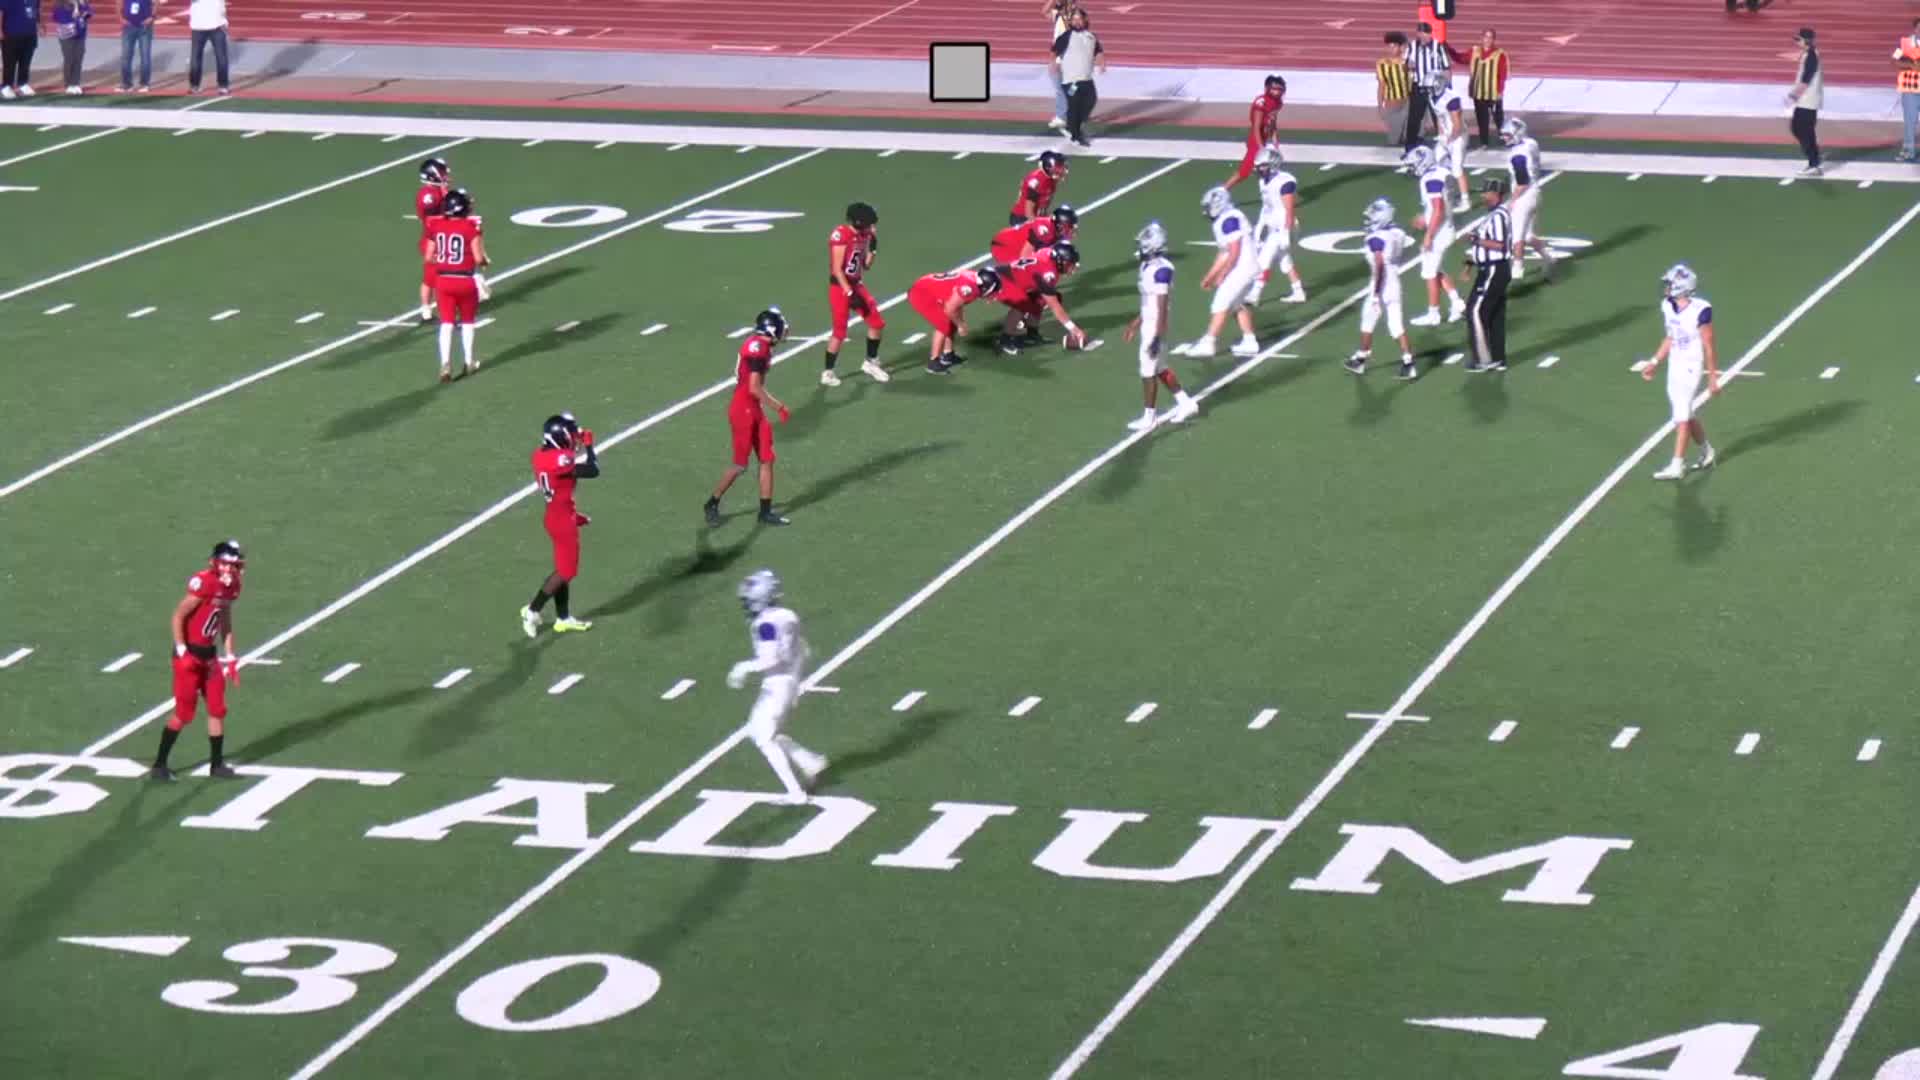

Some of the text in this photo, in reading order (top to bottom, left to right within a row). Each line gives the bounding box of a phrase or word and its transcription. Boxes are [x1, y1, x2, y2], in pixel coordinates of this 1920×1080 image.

[510, 204, 806, 233] 20
[436, 232, 464, 264] 19
[0, 752, 1633, 906] STADIUM
[162, 937, 661, 1032] 30
[1562, 1022, 1920, 1080] 4
